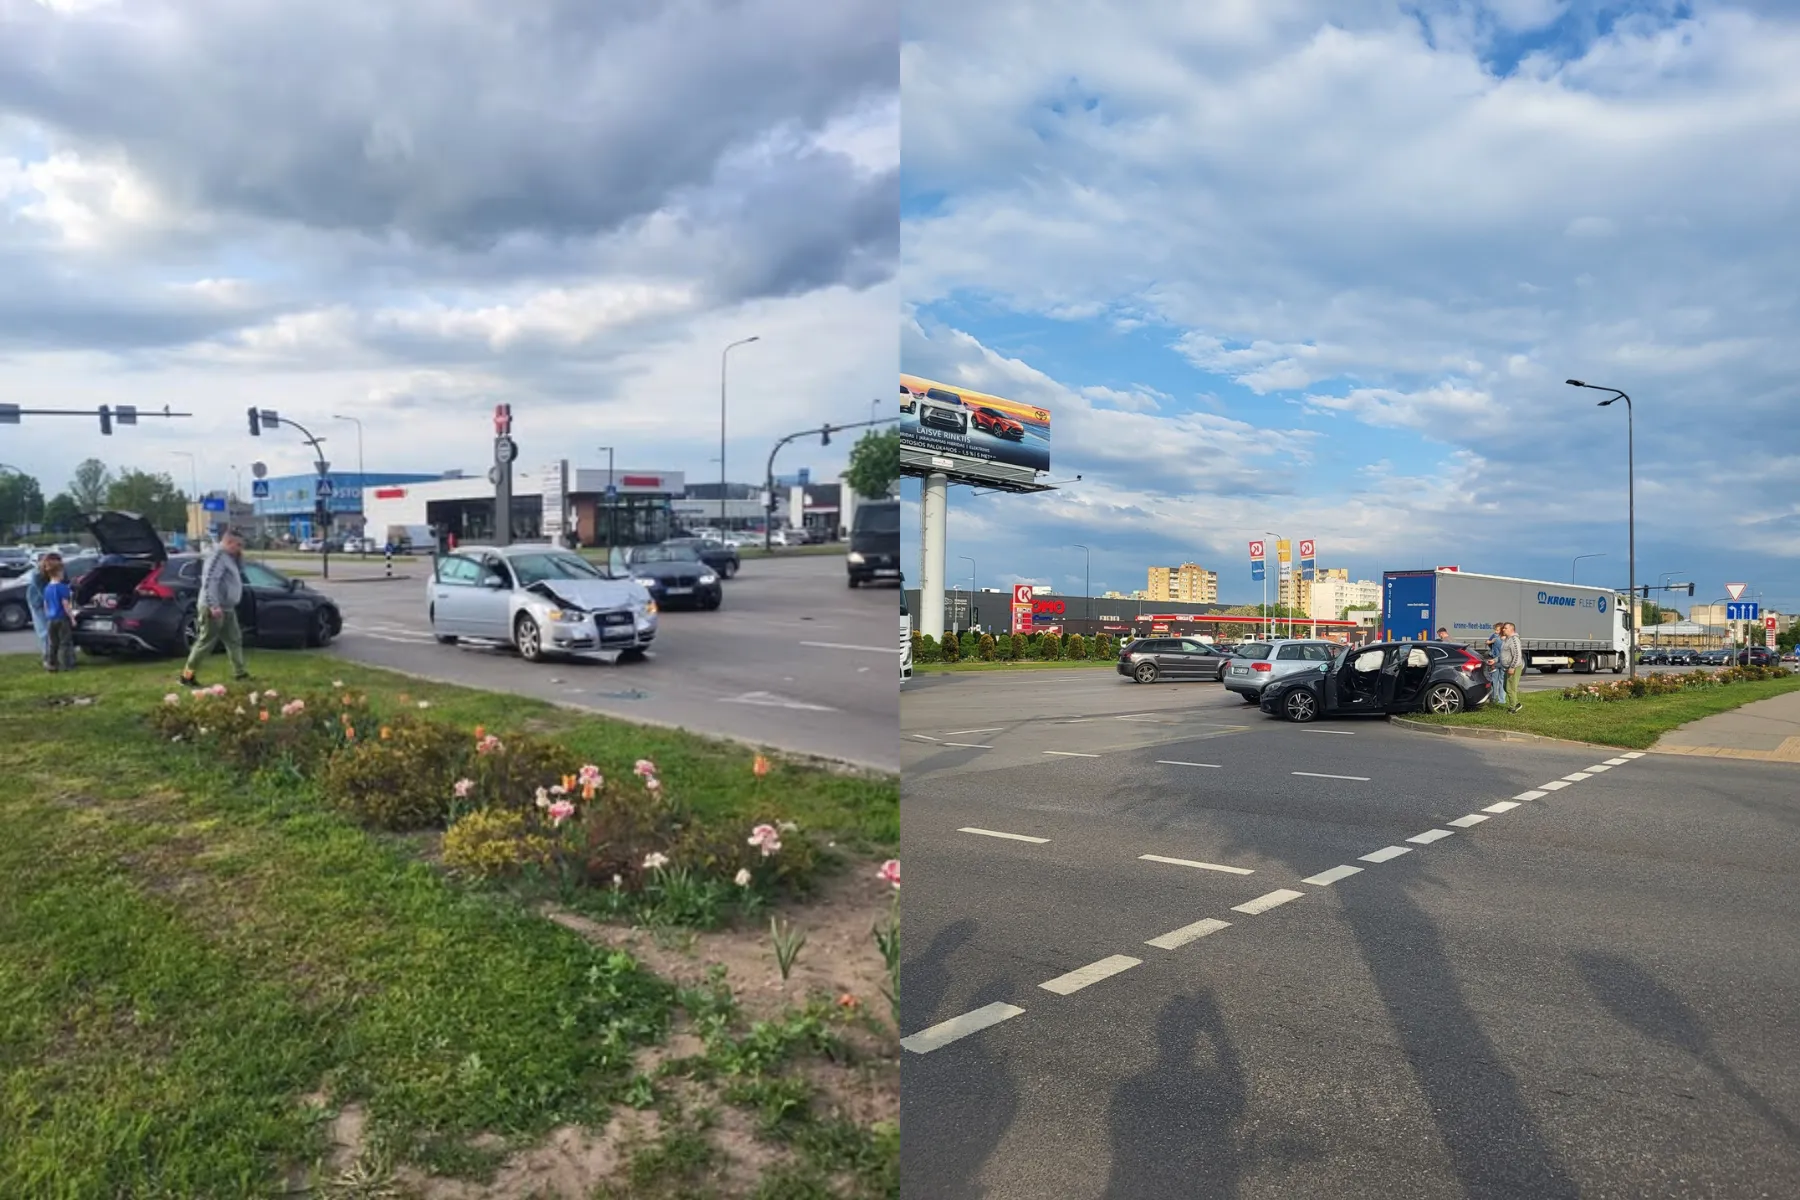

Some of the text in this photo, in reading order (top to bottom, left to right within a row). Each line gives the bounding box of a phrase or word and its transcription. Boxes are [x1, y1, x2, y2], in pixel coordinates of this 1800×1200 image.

[916, 426, 971, 443] LAISVĖ RINKTIS
[1547, 595, 1596, 608] KRONE FLEET
